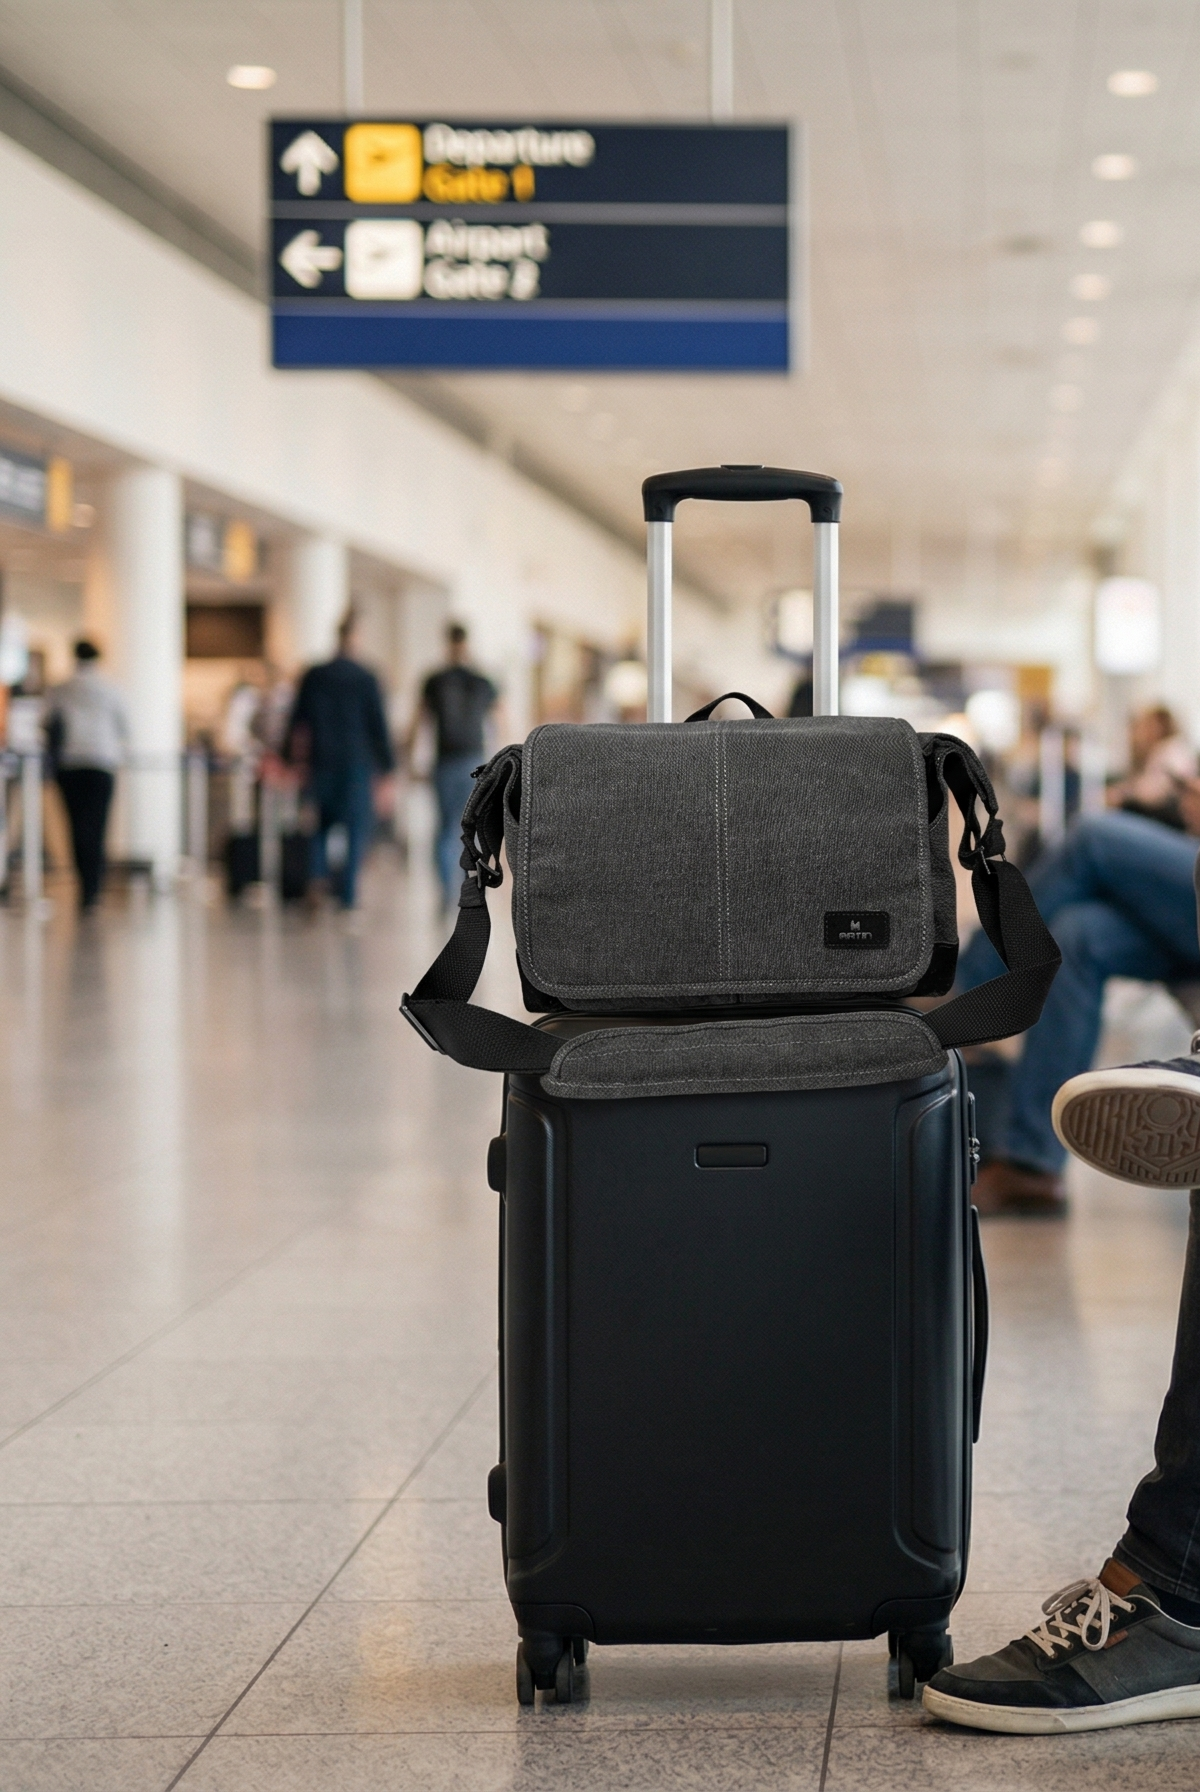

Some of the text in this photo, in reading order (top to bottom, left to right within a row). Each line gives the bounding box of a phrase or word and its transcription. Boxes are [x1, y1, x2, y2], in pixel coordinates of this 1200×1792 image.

[424, 123, 595, 167] Departure
[423, 162, 509, 204] Gate
[426, 218, 550, 262] Airport
[424, 257, 509, 300] Gate
